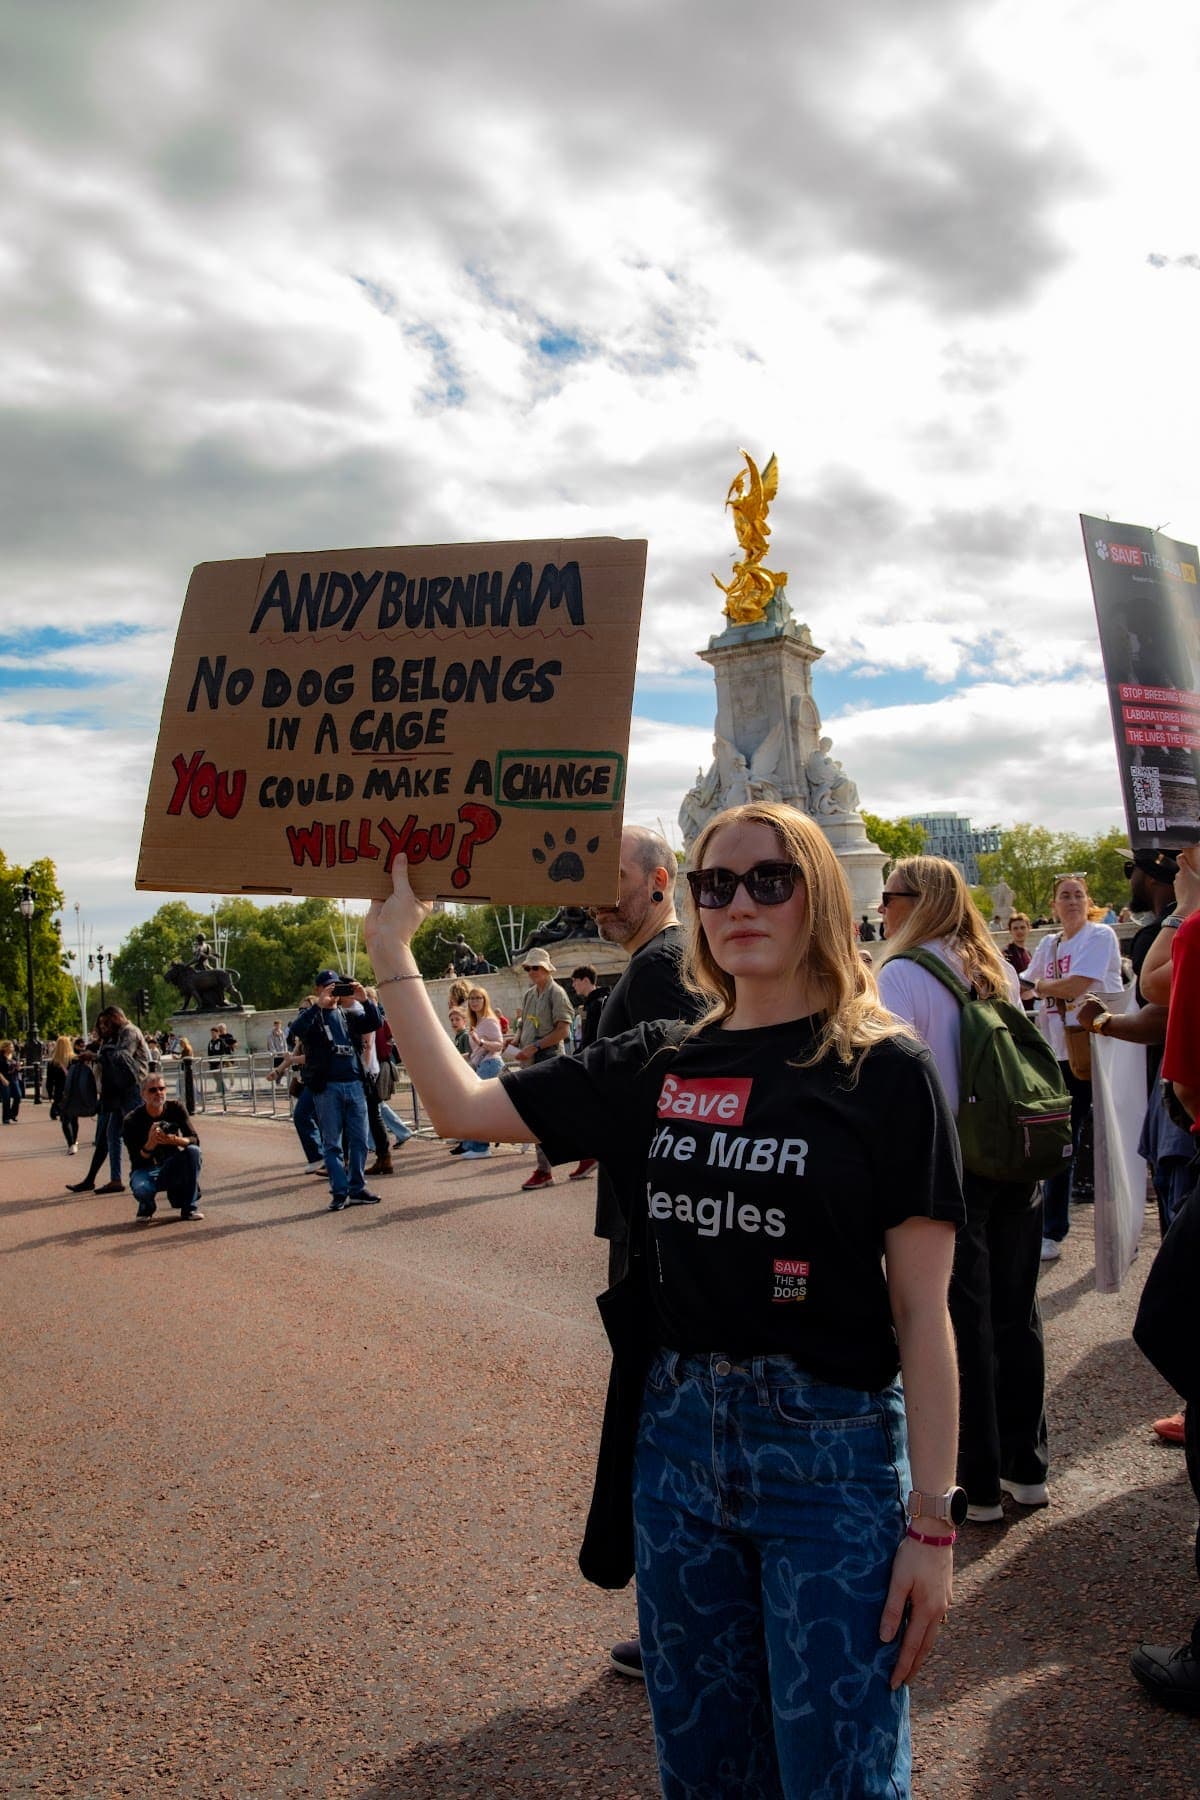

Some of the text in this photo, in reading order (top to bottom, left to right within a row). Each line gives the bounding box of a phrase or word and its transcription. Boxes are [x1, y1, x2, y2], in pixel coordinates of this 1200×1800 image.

[1110, 546, 1141, 565] SAVE
[1141, 551, 1161, 569] THE
[249, 561, 586, 634] ANDY BURNHAM
[261, 664, 354, 707] DOG
[372, 655, 562, 703] BELONGS
[1122, 687, 1143, 699] STOP
[267, 708, 448, 755] IN A CAGE
[1127, 730, 1144, 742] THE
[1144, 731, 1166, 743] LIVES
[166, 750, 611, 819] YOU COULD MAKE A CHANGE
[286, 817, 381, 868] WILL
[656, 1078, 740, 1119] Save
[706, 1131, 809, 1177] MBR
[774, 1274, 796, 1286] THE
[775, 1261, 807, 1275] SAVE
[773, 1286, 807, 1298] DOGS
